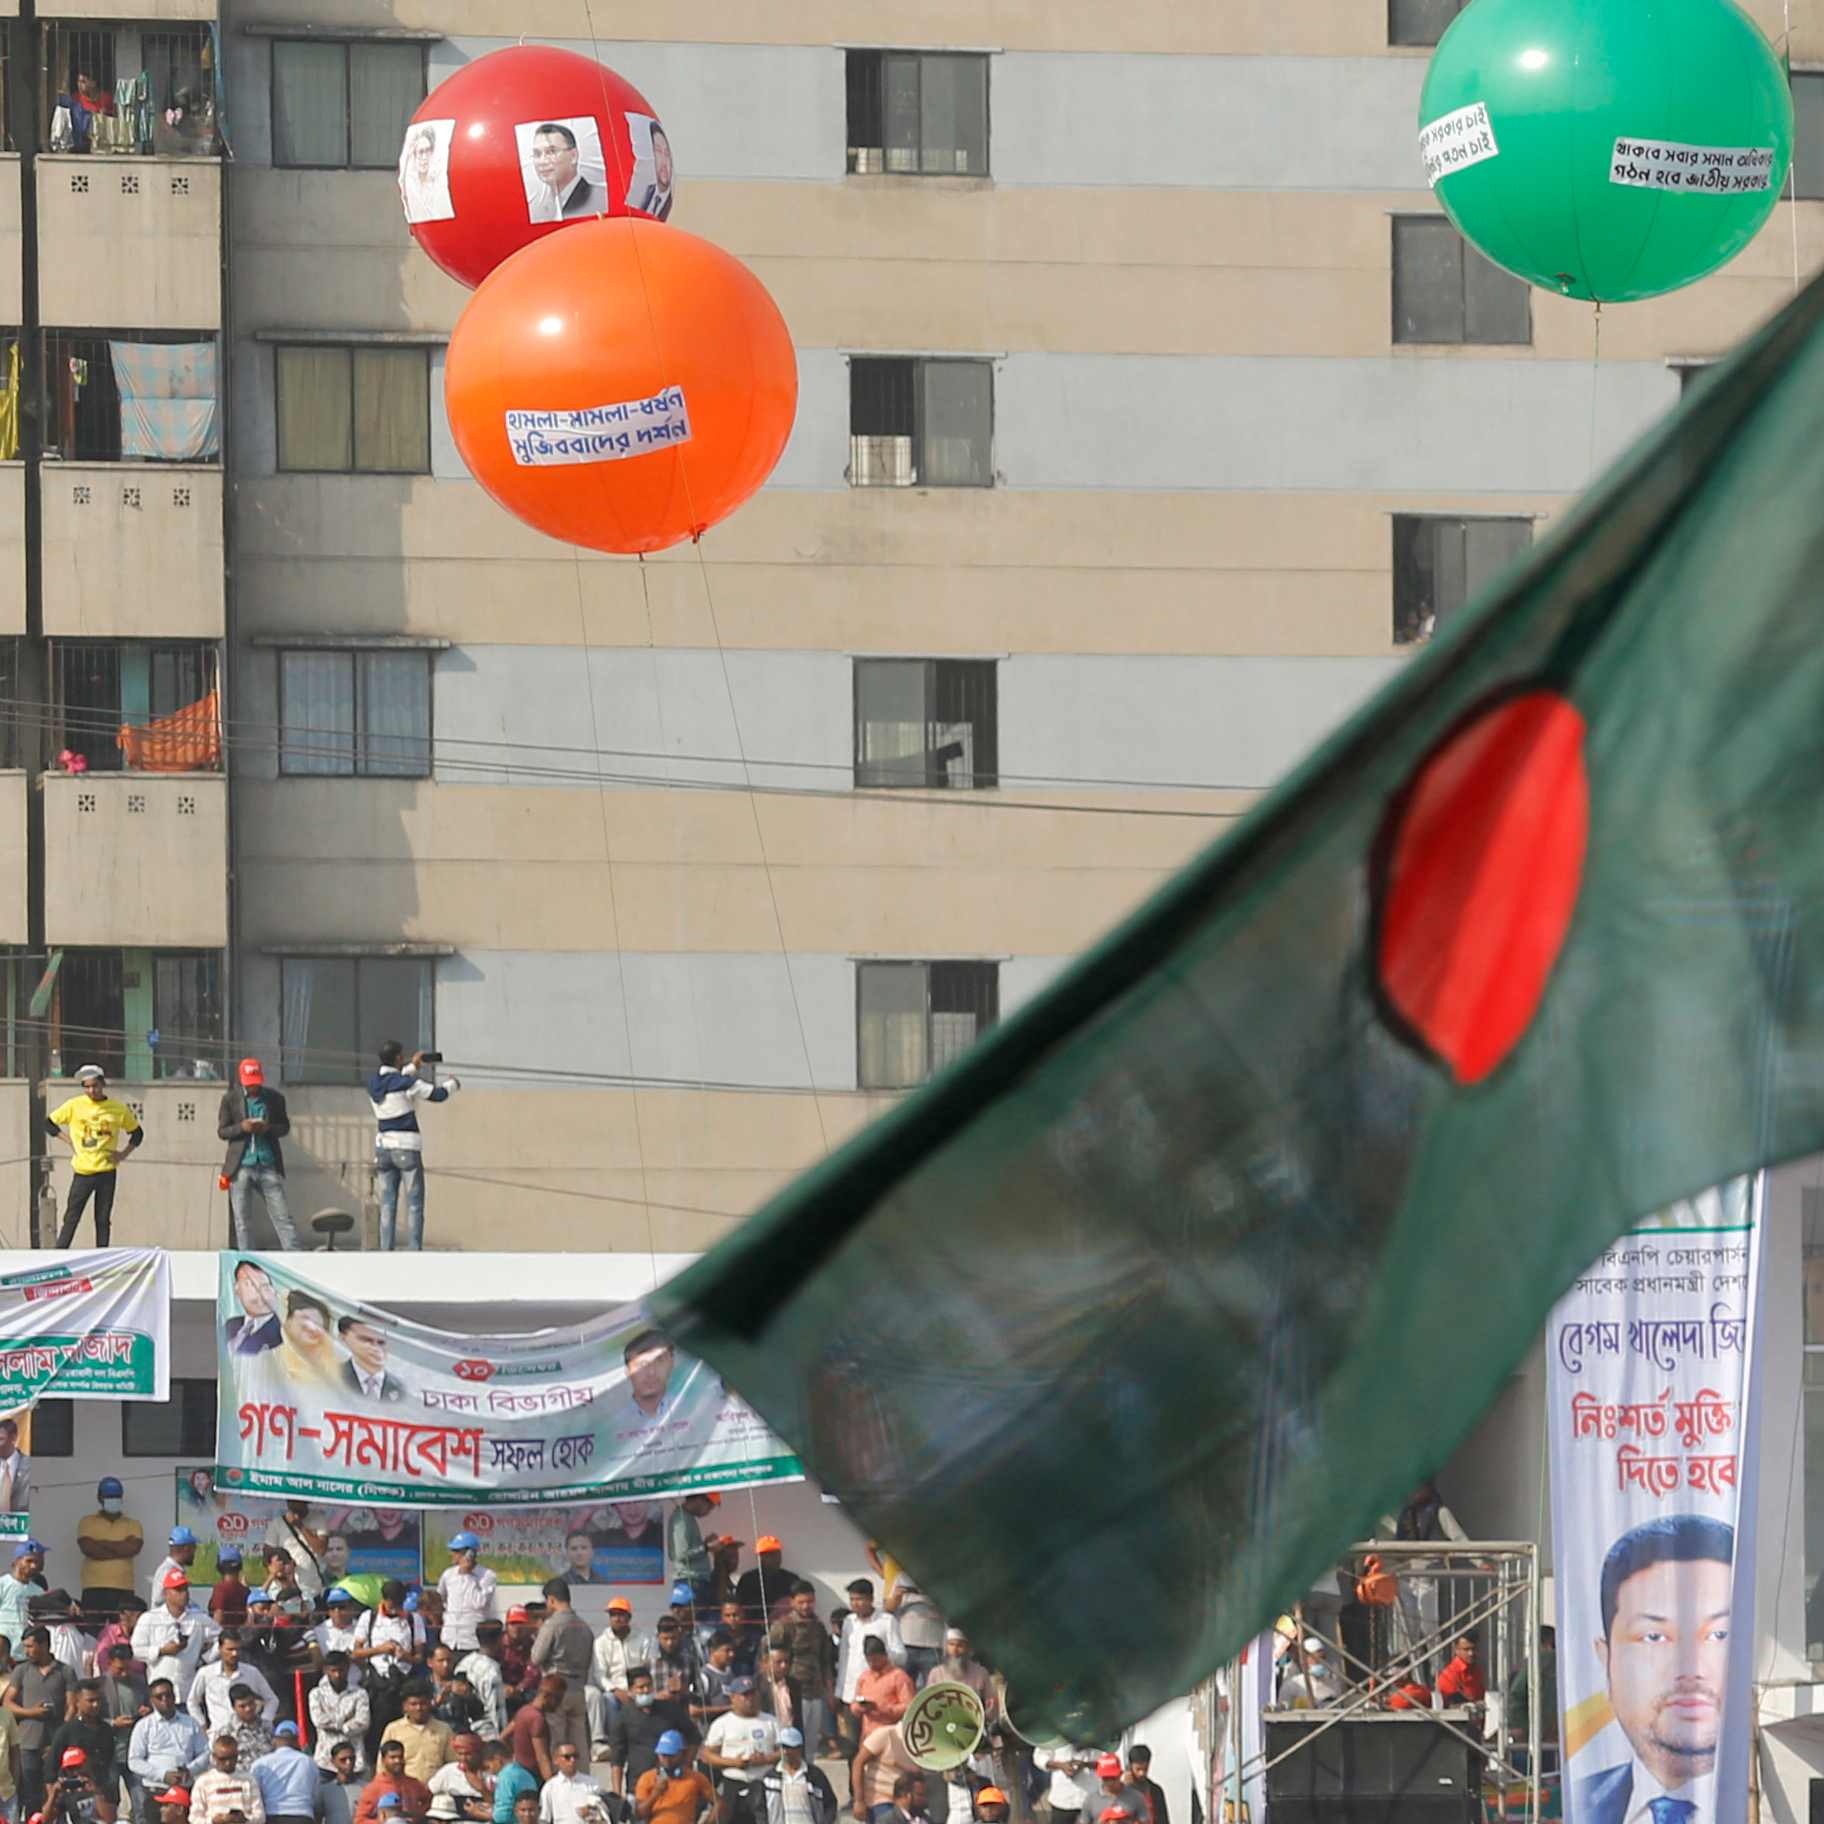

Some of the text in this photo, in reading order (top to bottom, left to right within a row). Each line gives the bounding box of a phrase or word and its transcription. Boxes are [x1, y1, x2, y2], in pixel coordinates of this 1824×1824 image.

[1664, 149, 1699, 166] সবার
[1613, 161, 1650, 181] গঠন
[1655, 171, 1681, 185] হবে
[1600, 1244, 1659, 1268] বিএনপি
[1576, 1270, 1705, 1296] সাবেক প্রধানমন্ত্রী
[1559, 1318, 1705, 1374] বেগম খালেদা
[459, 1361, 490, 1379] ১০
[421, 1384, 595, 1413] ঢাকা বিভাগীয়
[1571, 1386, 1734, 1448] নিঃশর্ত মুক্তি
[238, 1400, 595, 1477] গণ-সমাবেশ সফল হোক
[1616, 1443, 1738, 1497] দিতে হবে
